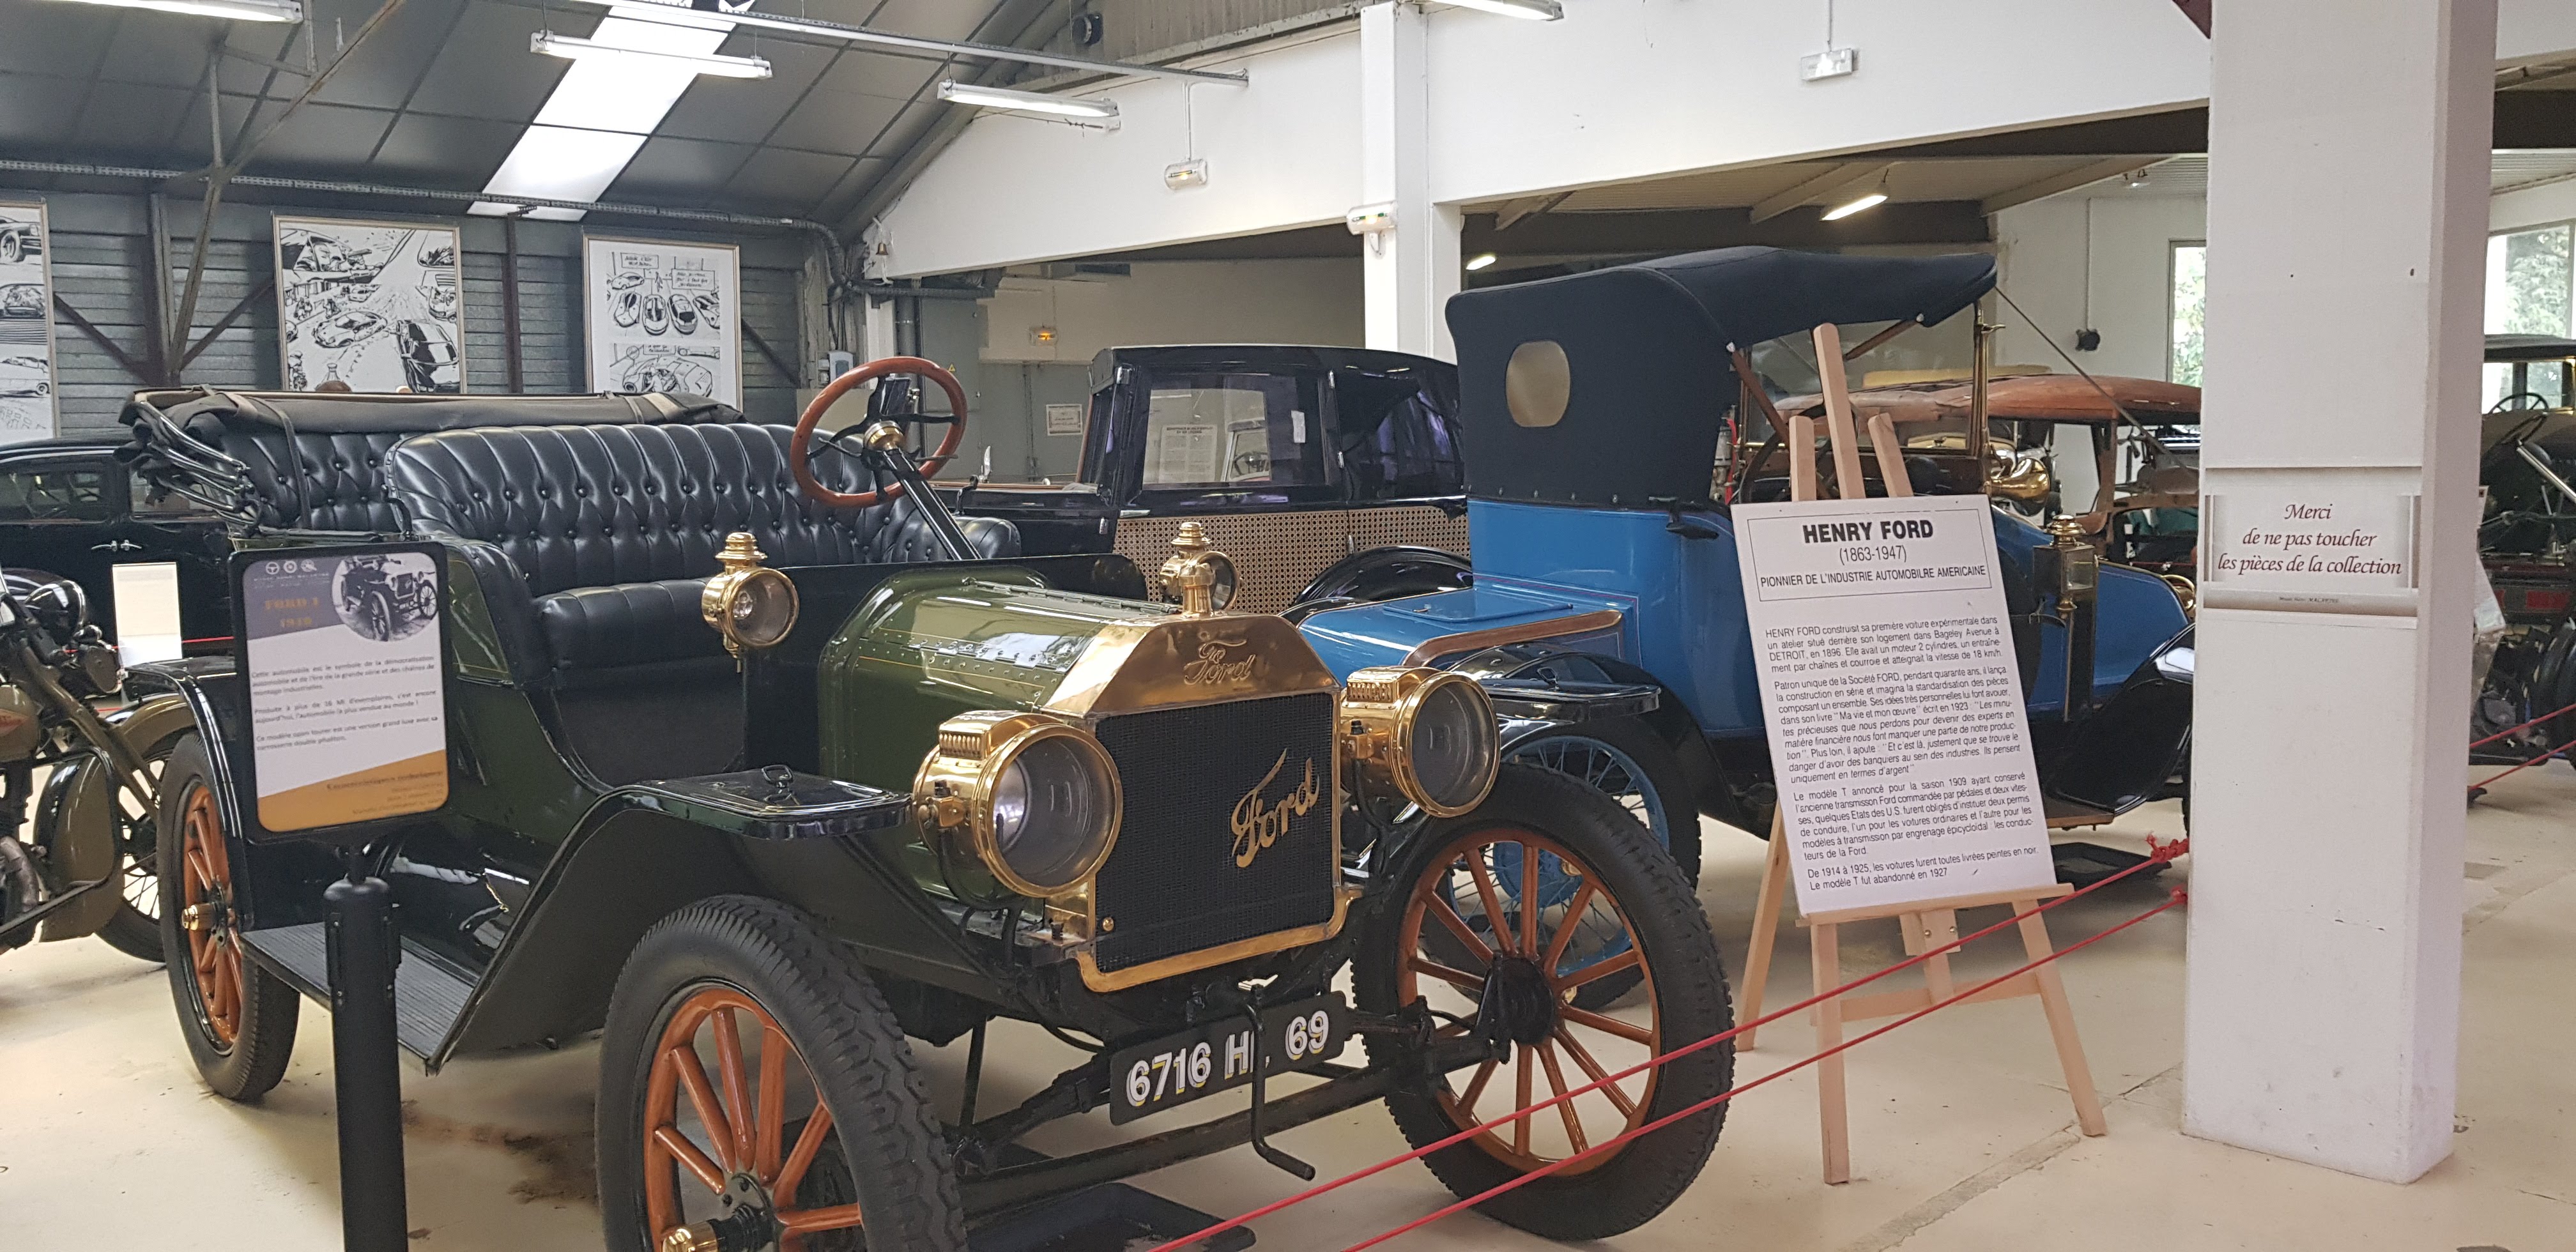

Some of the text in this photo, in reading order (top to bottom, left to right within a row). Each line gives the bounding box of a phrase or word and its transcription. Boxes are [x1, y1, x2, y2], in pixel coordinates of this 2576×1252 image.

[2285, 503, 2333, 519] Merci
[1802, 520, 1933, 544] HENRY FORD
[2242, 528, 2377, 551] de ne pas toucher
[1839, 545, 1906, 565] (1863-1947)
[2218, 553, 2402, 576] les pièces de la collection
[1761, 565, 1986, 587] PIONNIER DE L'INDUSTRIE AUTOMOBILRE AMERICAINE
[1765, 627, 1795, 637] HENRY
[1797, 626, 1821, 636] FORD
[1905, 620, 1929, 629] voiture
[1980, 615, 1997, 624] dans
[1827, 635, 1857, 645] derrière
[1876, 632, 1910, 644] logement
[1913, 630, 1931, 639] dans
[1965, 626, 1991, 636] Avenue
[1860, 646, 1878, 654] avait
[1891, 643, 1917, 652] moteur
[1183, 654, 1256, 685] Ford
[1771, 663, 1791, 672] ment
[1793, 663, 1807, 673] par
[1961, 650, 1970, 659] de
[1973, 649, 1982, 658] 18
[1774, 679, 1800, 690] Patron
[1801, 678, 1828, 690] unique
[1839, 676, 1847, 685] la
[1903, 670, 1933, 682] pendant
[1775, 692, 1783, 701] la
[1785, 690, 1832, 701] construction
[1915, 678, 1968, 691] standardisation
[1970, 678, 1984, 687] des
[1778, 689, 1984, 715] composant Ses très personnelles font
[1780, 714, 1800, 724] dans
[1853, 710, 1864, 719] vie
[1874, 709, 1890, 717] mon
[1951, 701, 1968, 711] 1923
[1782, 717, 1930, 737] tes précieuses que nous perdons pour
[1852, 734, 1871, 742] nous
[1872, 731, 1887, 740] font
[1888, 730, 1921, 741] manquer
[1970, 724, 1988, 732] notre
[1811, 747, 1827, 758] Plus
[1853, 744, 1876, 756] ajoute
[1963, 737, 1977, 746] que
[1988, 733, 2011, 742] trouve
[1788, 749, 1943, 774] danger des banquiers des
[1850, 768, 1876, 778] termes
[1793, 771, 2025, 801] Le modèle T annoncé pour la 1909 ayant conservé
[1879, 795, 1896, 805] Ford
[1897, 790, 1942, 803] commandée
[1943, 791, 1955, 800] par
[1992, 784, 2009, 794] deux
[1231, 749, 1321, 868] Ford
[1814, 804, 1924, 825] quelques Etats des furent
[1800, 827, 1811, 837] de
[1869, 821, 1886, 832] pour
[1888, 818, 1899, 828] les
[1901, 816, 1930, 827] voitures
[1802, 827, 1945, 848] modèles par engrenage
[1804, 847, 1846, 860] teurs la
[1807, 868, 1819, 878] De
[1821, 866, 1840, 876] 1914
[1873, 862, 1883, 871] les
[1915, 856, 1936, 867] furent
[1938, 854, 1960, 864] toutes
[1810, 881, 1820, 890] Le
[1822, 877, 1851, 889] modèle
[1853, 876, 1859, 885] T
[1861, 875, 1871, 885] fut
[1873, 870, 1915, 883] abandonné
[1930, 867, 1947, 877] 1927
[1126, 1042, 1211, 1107] 6716
[1285, 1011, 1329, 1060] 69
